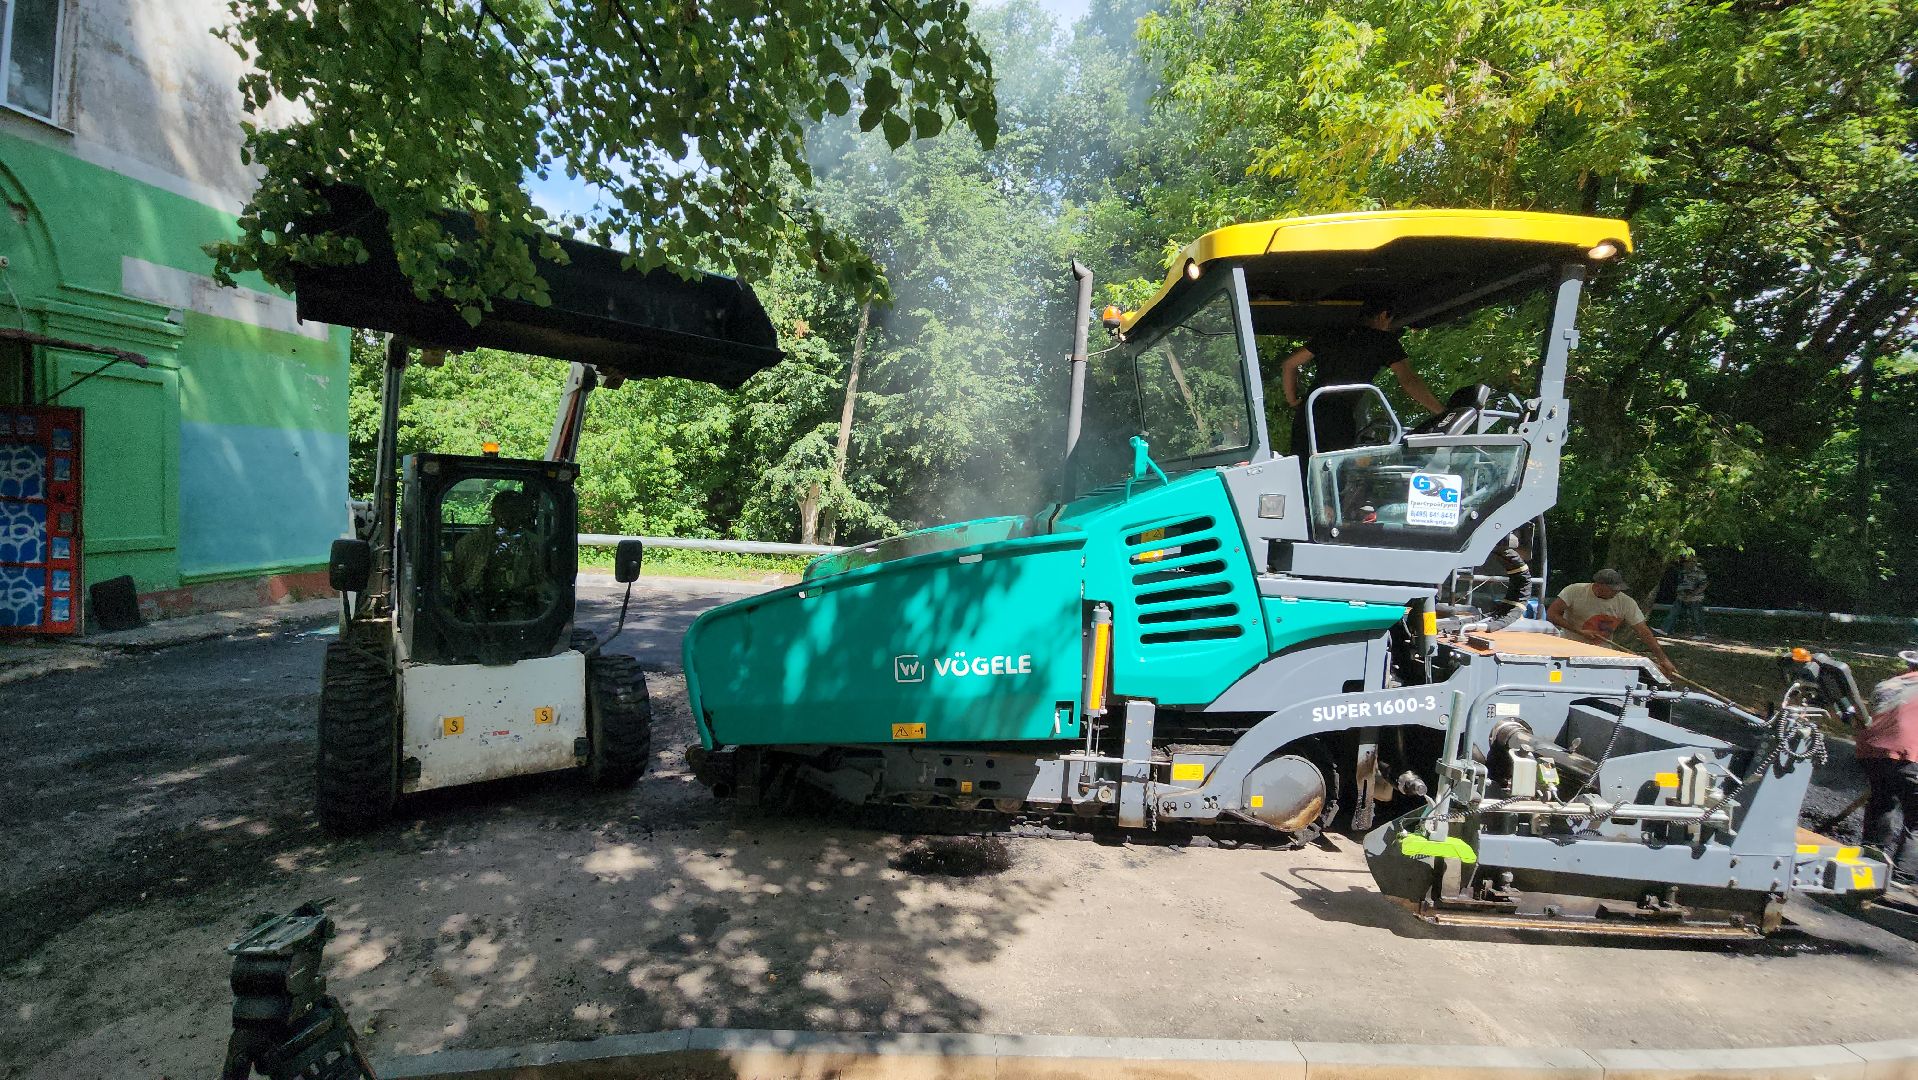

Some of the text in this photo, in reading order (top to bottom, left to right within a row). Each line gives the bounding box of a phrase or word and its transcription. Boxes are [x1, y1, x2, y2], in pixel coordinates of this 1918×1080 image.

[934, 651, 1032, 677] VÖGELE
[1312, 695, 1437, 722] SUPER 1600-3
